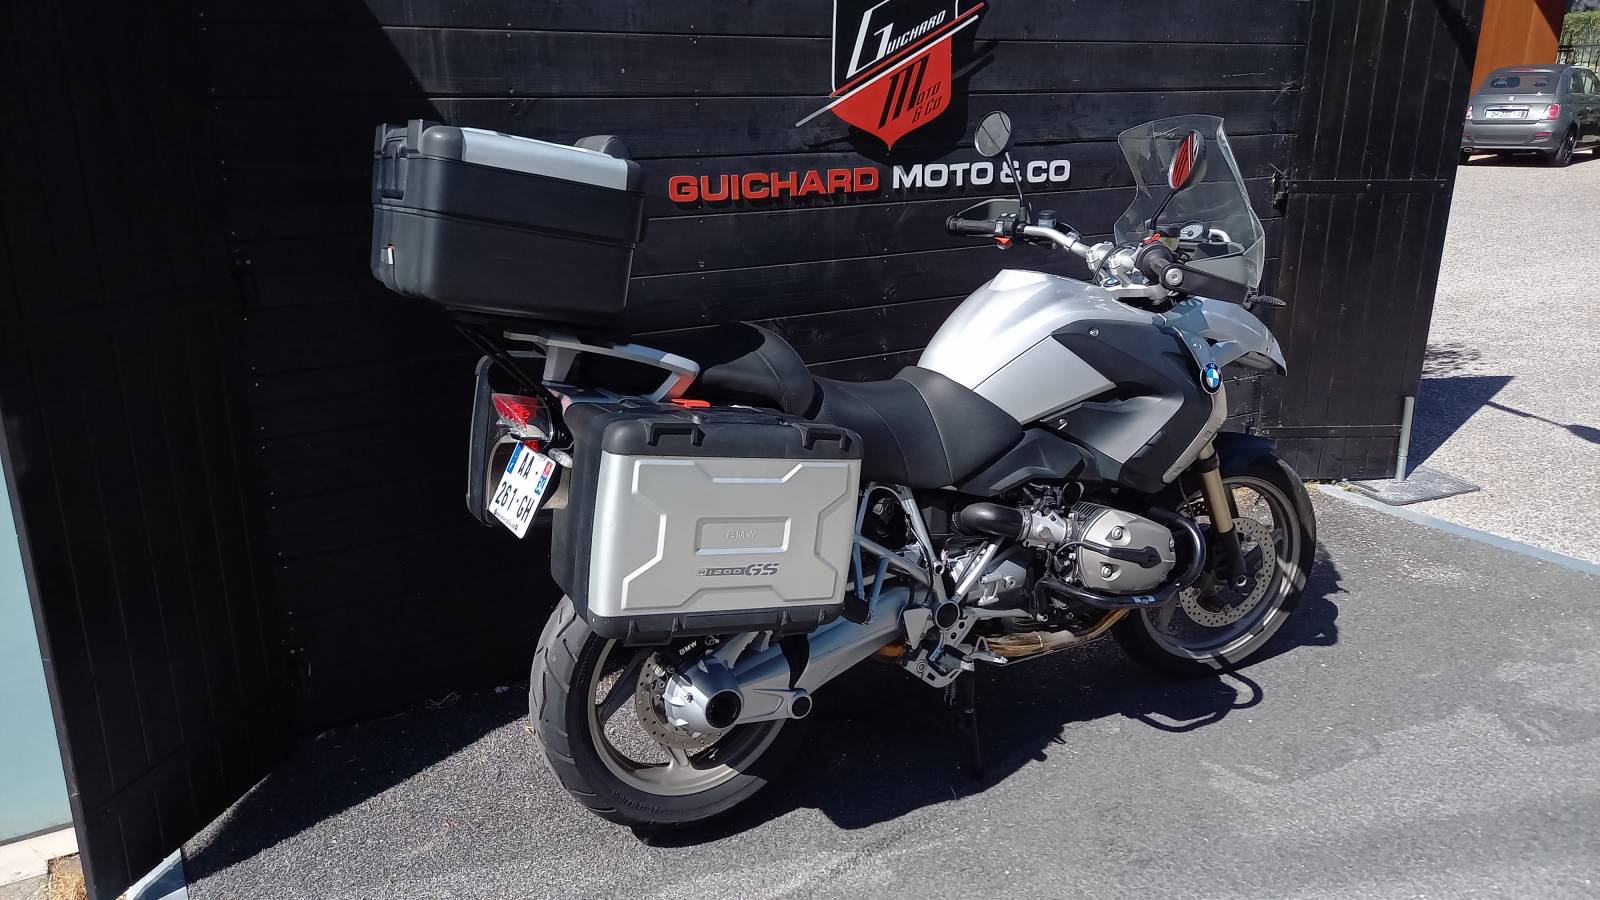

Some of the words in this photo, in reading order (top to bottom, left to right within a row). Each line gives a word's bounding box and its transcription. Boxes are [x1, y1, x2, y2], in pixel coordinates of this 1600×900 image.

[668, 166, 880, 203] GUICHARD
[892, 161, 994, 190] MOTO
[1000, 160, 1022, 183] &
[1027, 159, 1071, 183] CO
[726, 528, 757, 540] BMW
[678, 640, 698, 656] BMW
